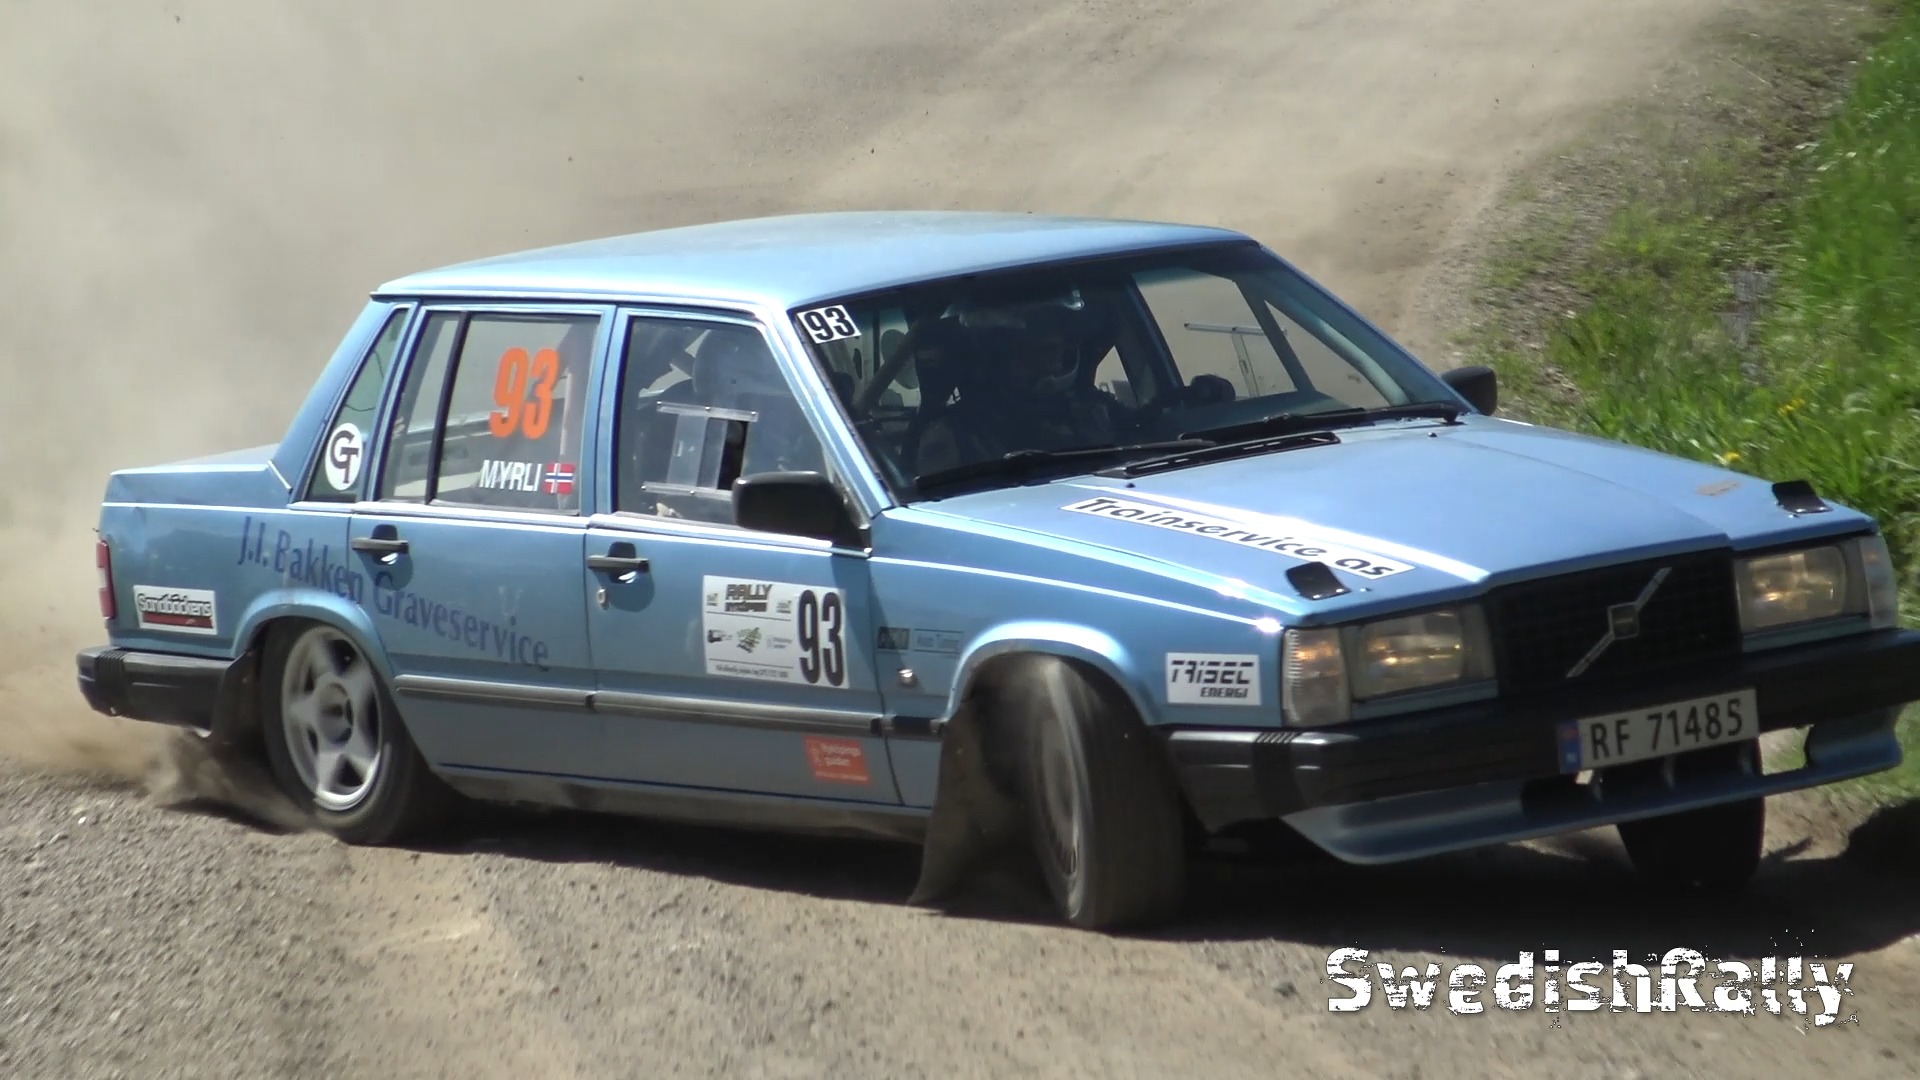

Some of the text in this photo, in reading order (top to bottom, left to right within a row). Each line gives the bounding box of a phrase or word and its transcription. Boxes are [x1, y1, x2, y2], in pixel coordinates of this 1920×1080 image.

[798, 307, 855, 340] 93
[489, 347, 560, 439] 93
[330, 430, 359, 484] GT
[479, 459, 542, 492] MYRLI
[1074, 498, 1396, 577] Trainservice as
[274, 530, 364, 605] Bakken
[373, 571, 550, 672] Graveservice
[726, 584, 773, 601] RALLY
[798, 590, 844, 687] 93
[1200, 687, 1249, 698] ENERGI
[1591, 698, 1742, 759] RF 71485
